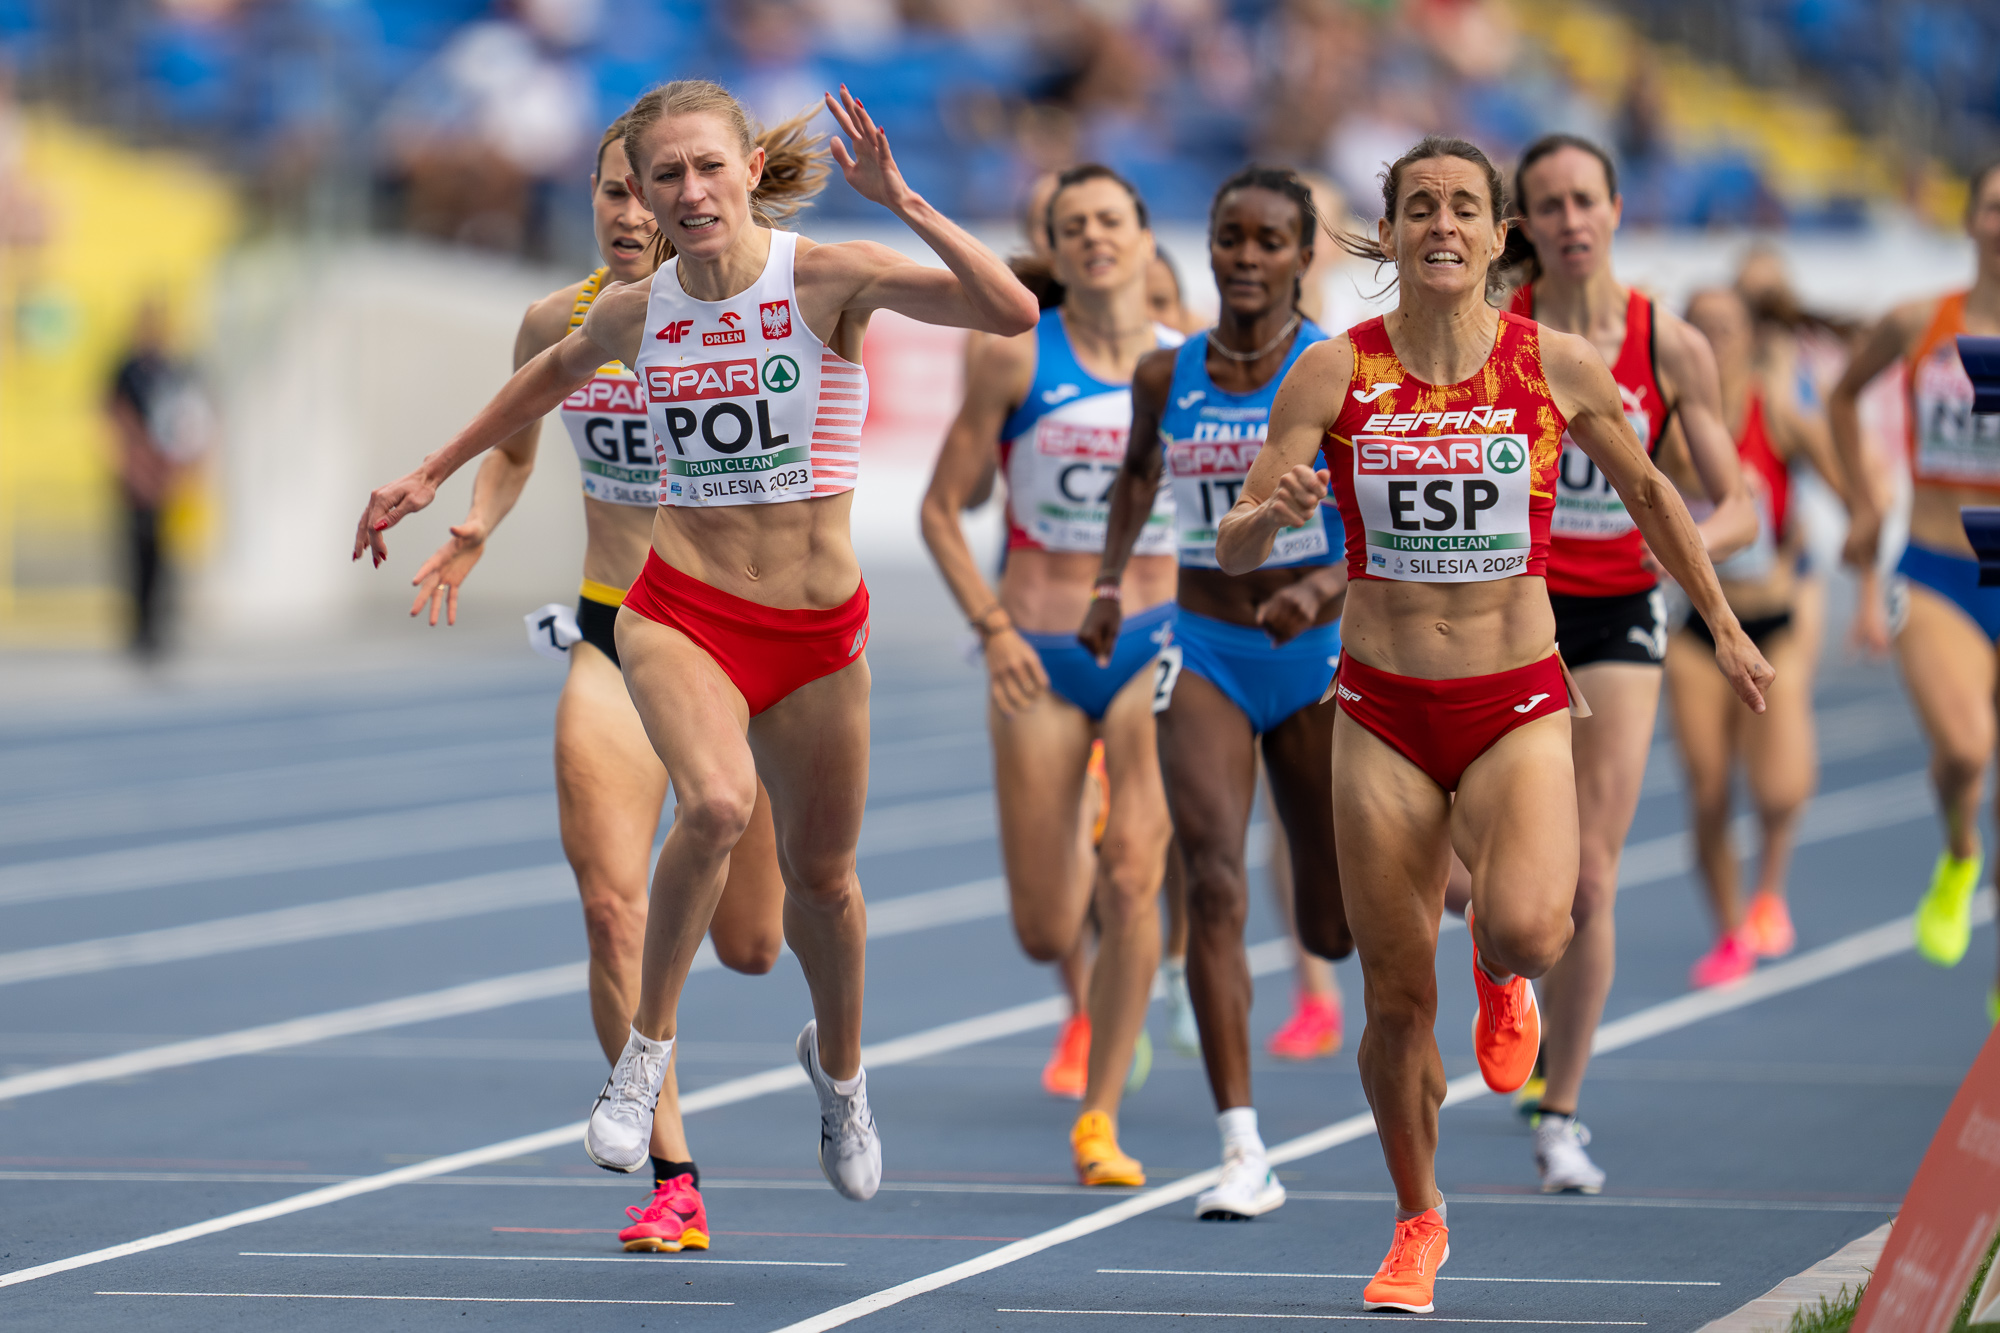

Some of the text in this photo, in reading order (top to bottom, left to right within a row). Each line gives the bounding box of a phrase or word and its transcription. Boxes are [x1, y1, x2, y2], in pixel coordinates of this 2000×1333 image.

[656, 320, 694, 343] 4F
[704, 331, 743, 344] ORLEN
[650, 364, 755, 397] SPAR
[665, 399, 789, 455] POL
[1362, 405, 1516, 431] ESPAÑA
[585, 417, 660, 465] GE
[690, 460, 723, 475] RUN
[1361, 443, 1479, 470] SPAR
[613, 486, 660, 503] SILESI
[702, 469, 808, 497] SILESIA 2023
[1200, 481, 1242, 523] IT
[1388, 480, 1499, 531] ESP
[1401, 537, 1434, 550] RUN
[1410, 555, 1524, 574] SILESIA 2023
[1337, 683, 1362, 702] ESP
